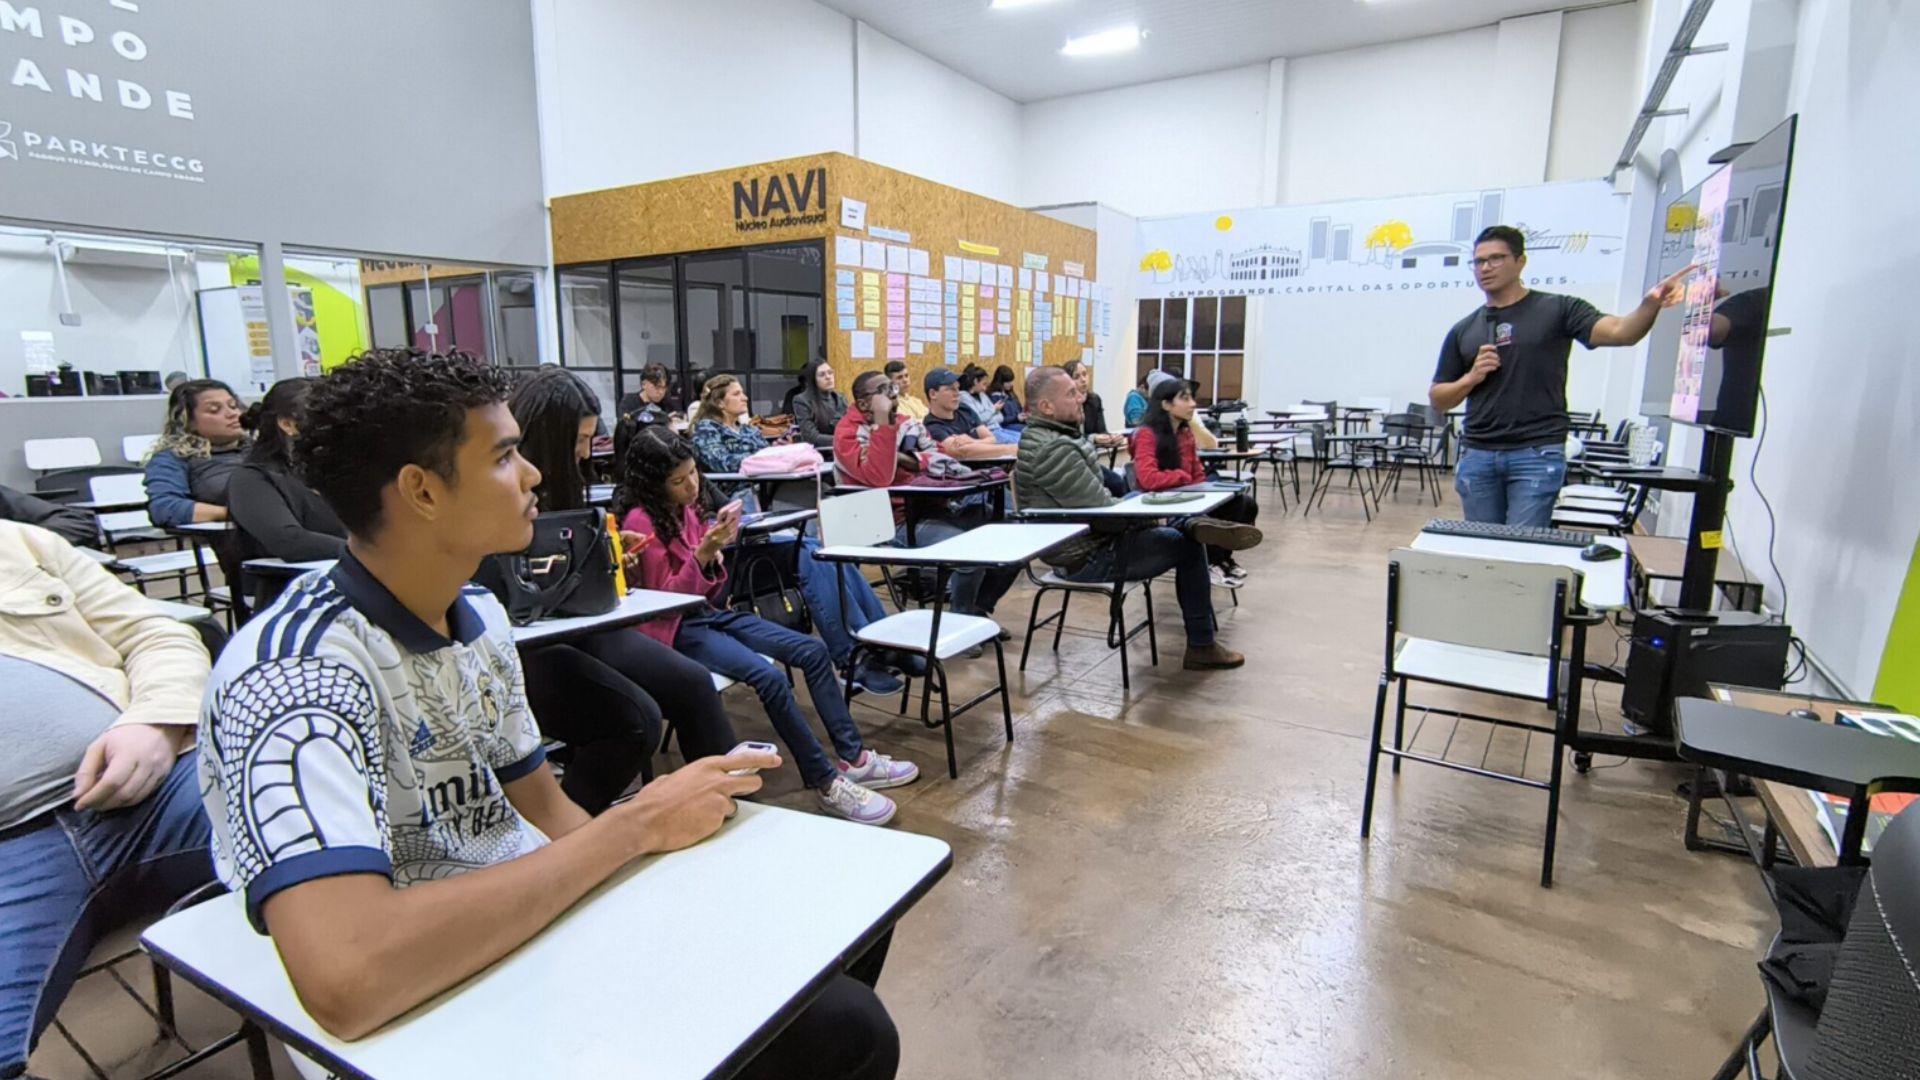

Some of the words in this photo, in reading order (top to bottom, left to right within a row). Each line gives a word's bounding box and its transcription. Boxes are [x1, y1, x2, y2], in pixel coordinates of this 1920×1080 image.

[23, 131, 204, 173] PARKTECCG
[733, 168, 826, 219] NAVI
[770, 211, 827, 228] Audiovisual
[1169, 289, 1214, 297] CAMPO
[1286, 285, 1355, 294] CAPITAL
[1362, 283, 1394, 291] DAS
